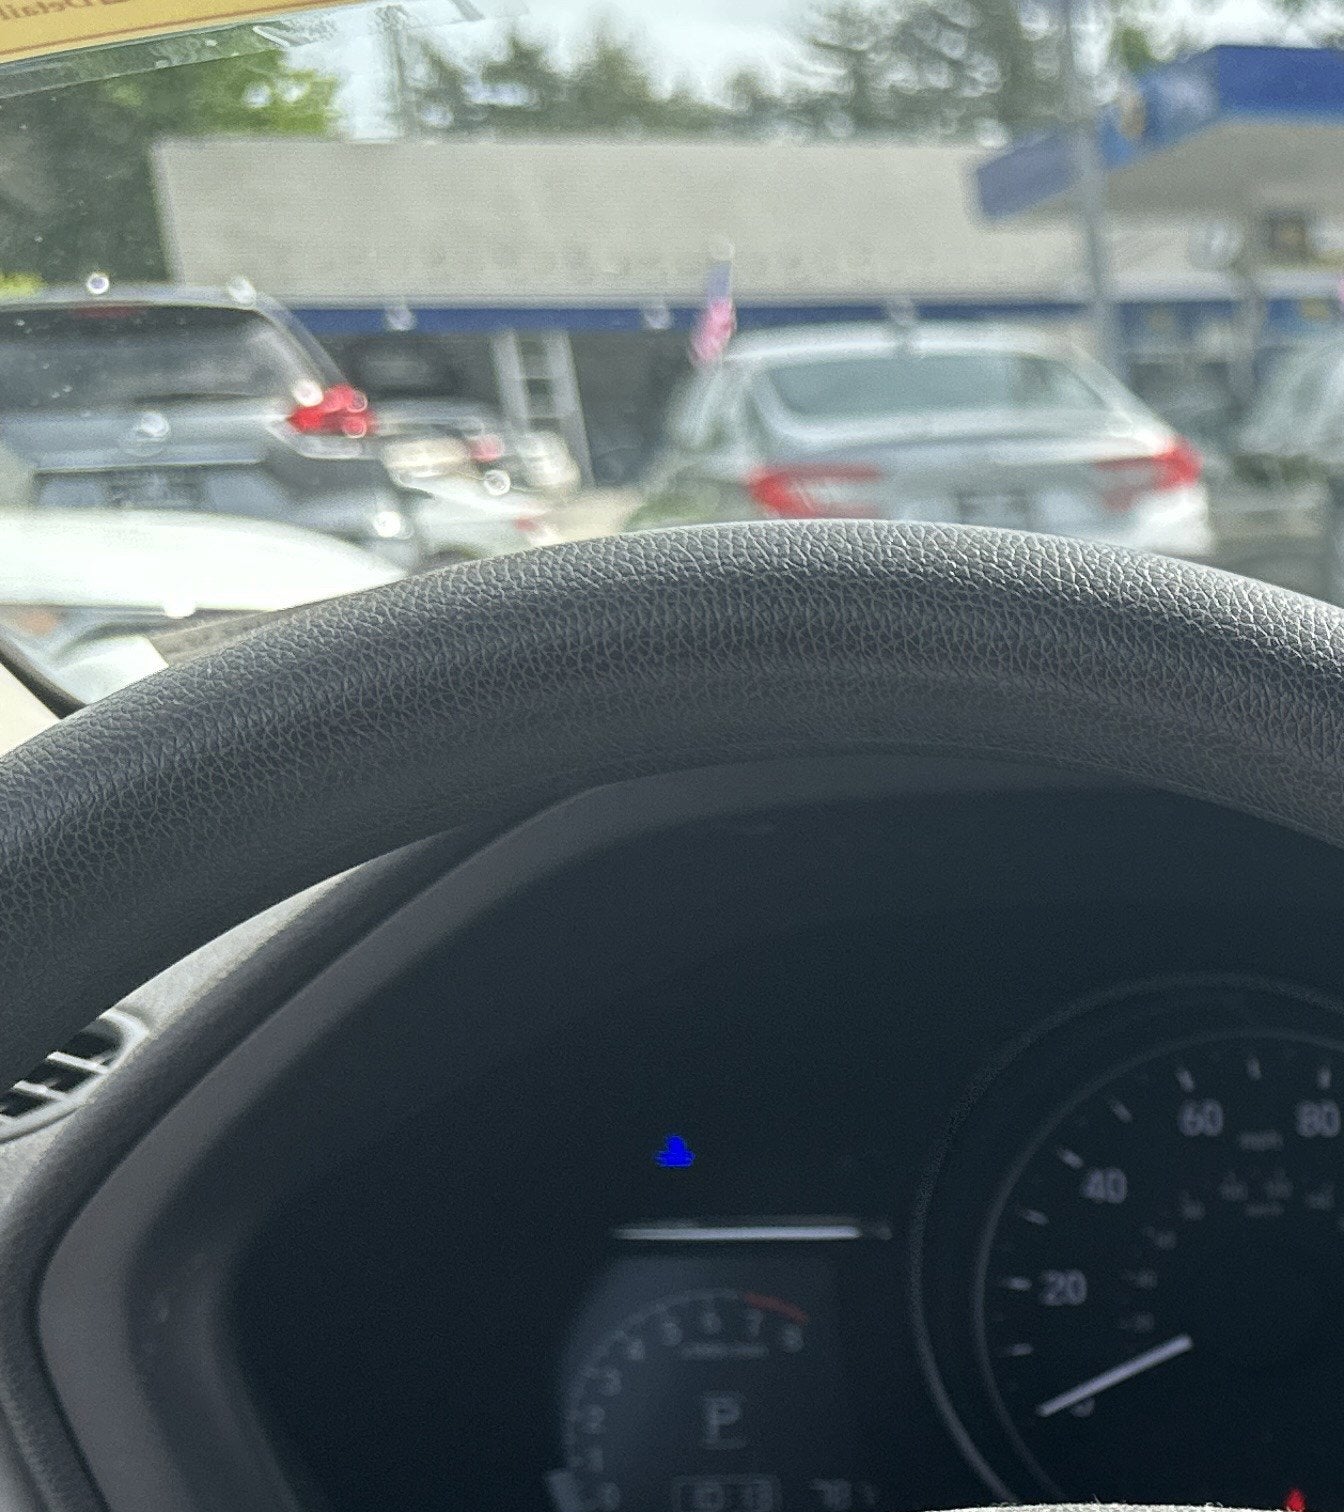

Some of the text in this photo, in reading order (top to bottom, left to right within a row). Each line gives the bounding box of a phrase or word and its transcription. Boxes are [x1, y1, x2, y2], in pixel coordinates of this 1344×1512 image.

[1178, 1100, 1224, 1137] 60
[1294, 1099, 1340, 1138] 80
[1082, 1168, 1127, 1204] 40
[1040, 1270, 1087, 1305] 20
